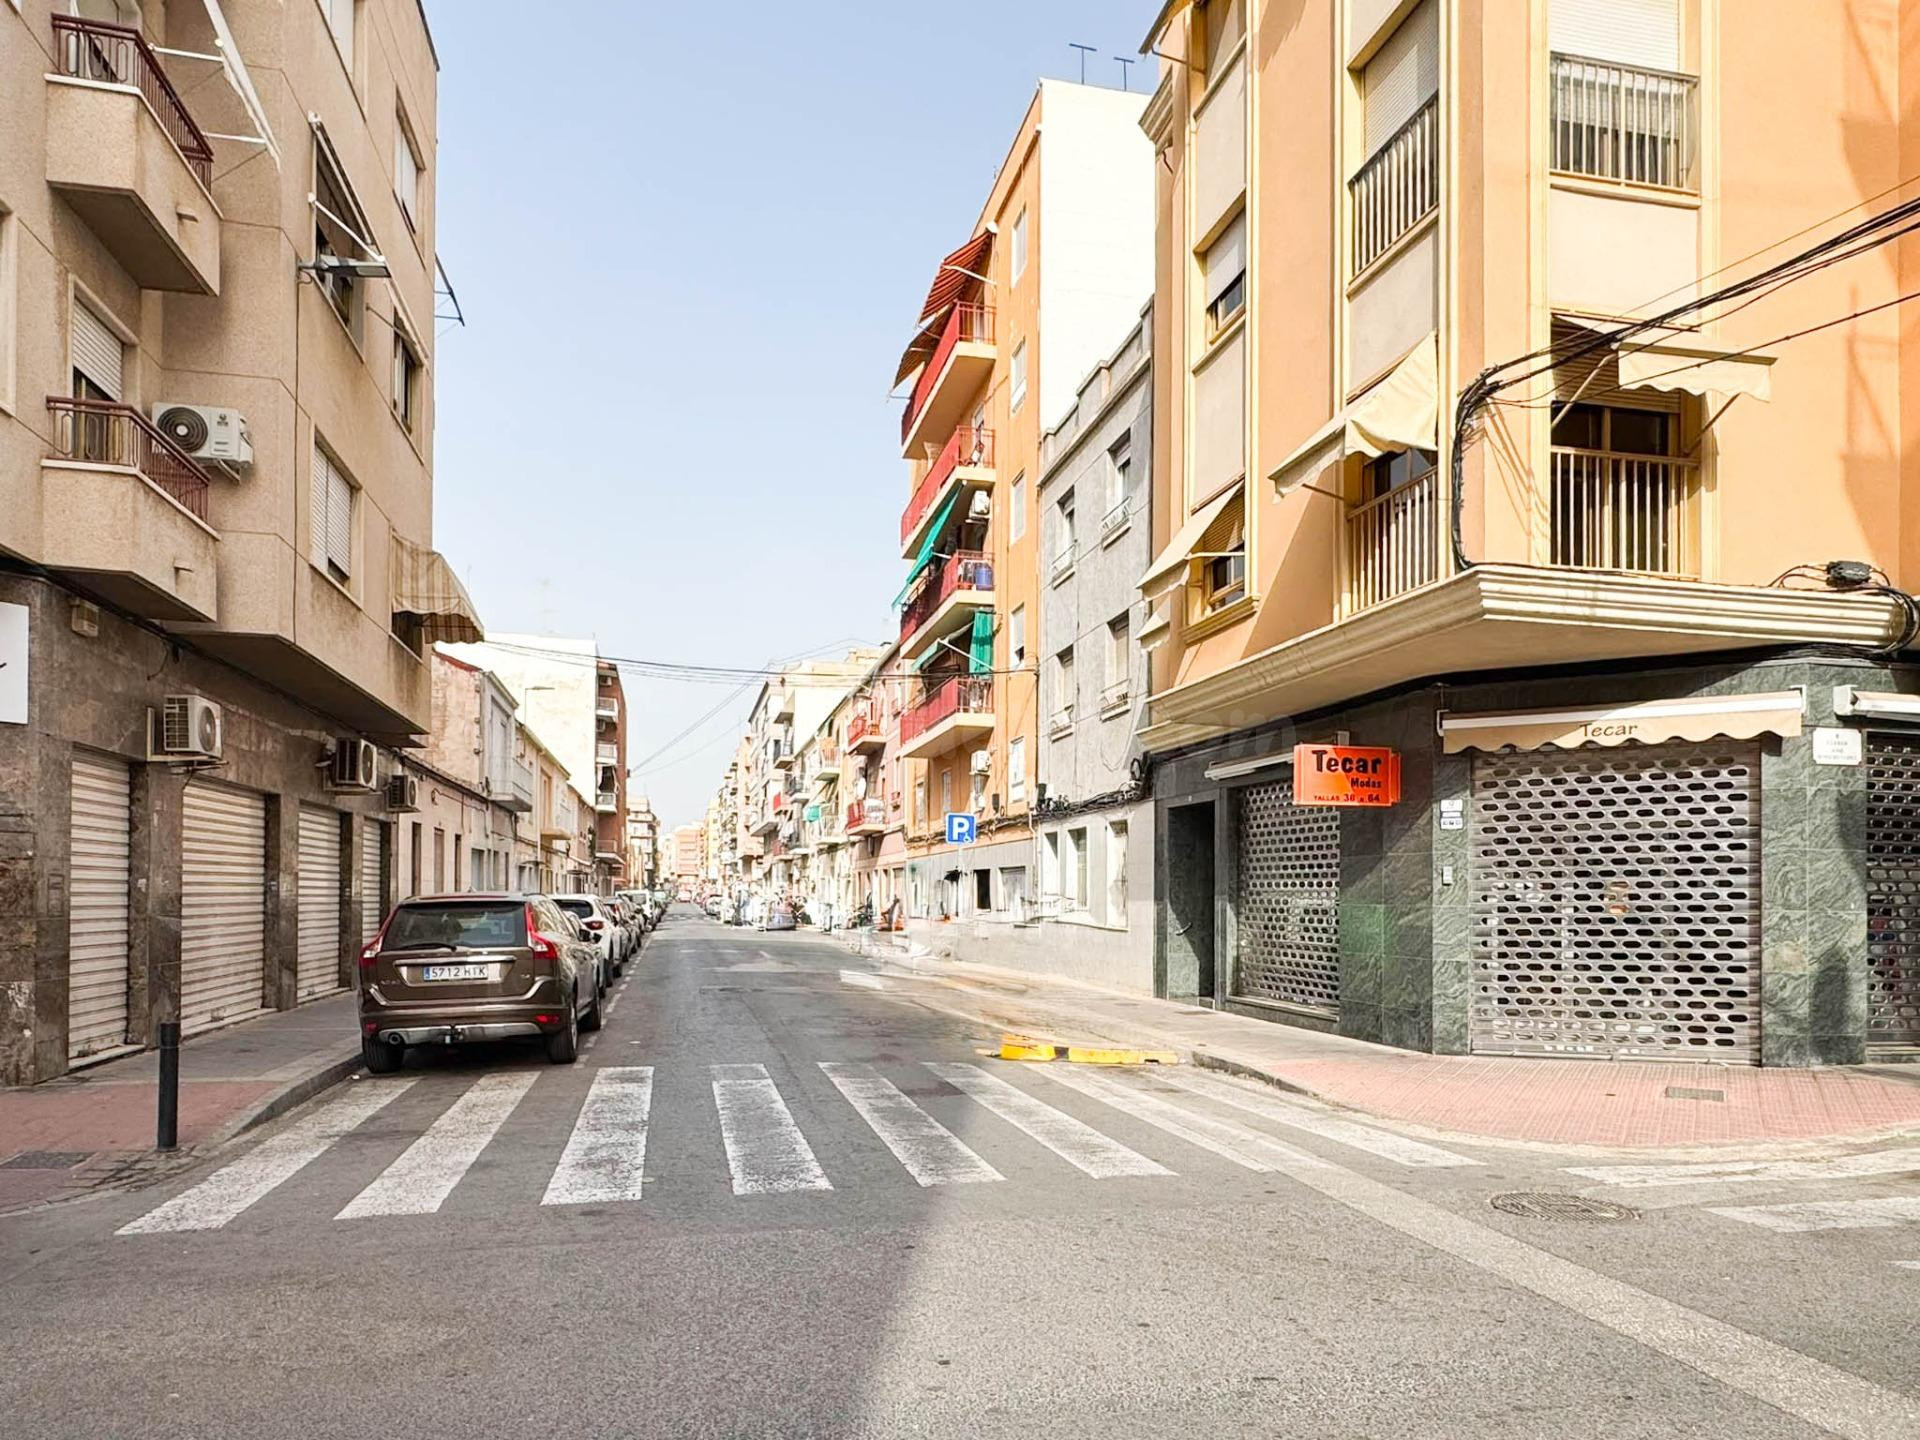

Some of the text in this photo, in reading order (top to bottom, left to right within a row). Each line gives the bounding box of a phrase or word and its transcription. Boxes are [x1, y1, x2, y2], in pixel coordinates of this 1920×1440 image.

[1580, 722, 1638, 737] Tecar
[1311, 749, 1382, 774] Tecar
[1350, 778, 1382, 788] Modas
[952, 817, 970, 841] P
[432, 967, 460, 977] 5712
